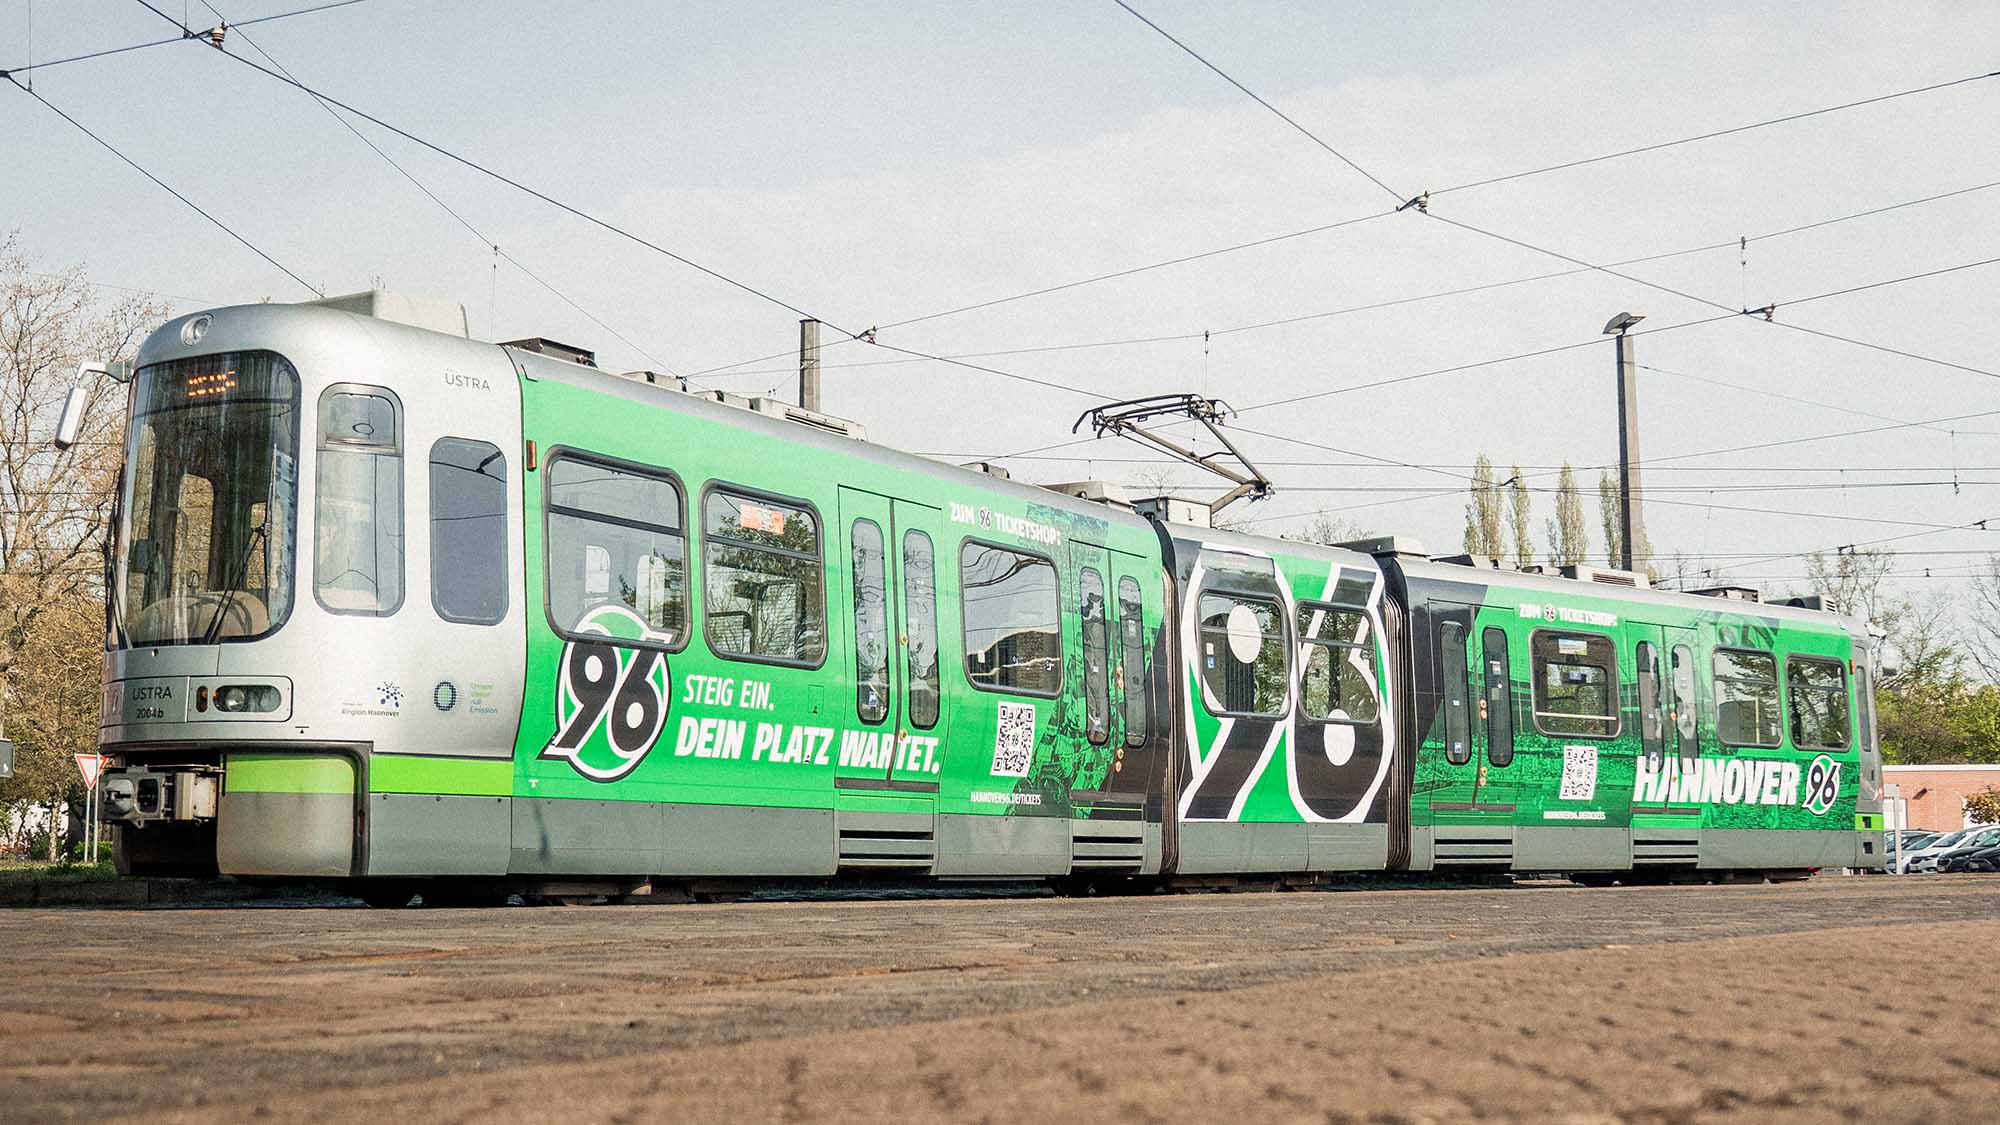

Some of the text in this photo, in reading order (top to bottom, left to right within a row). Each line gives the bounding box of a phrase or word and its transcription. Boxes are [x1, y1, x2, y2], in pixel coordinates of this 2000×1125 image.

[949, 502, 976, 524] ZUM
[978, 508, 992, 529] 96
[548, 622, 672, 758] 96
[682, 674, 775, 711] STEIG EIN.
[1181, 546, 1396, 822] 96
[674, 716, 940, 775] DEIN PLATZ WARTET.
[1632, 755, 1841, 810] HANNOVER 96
